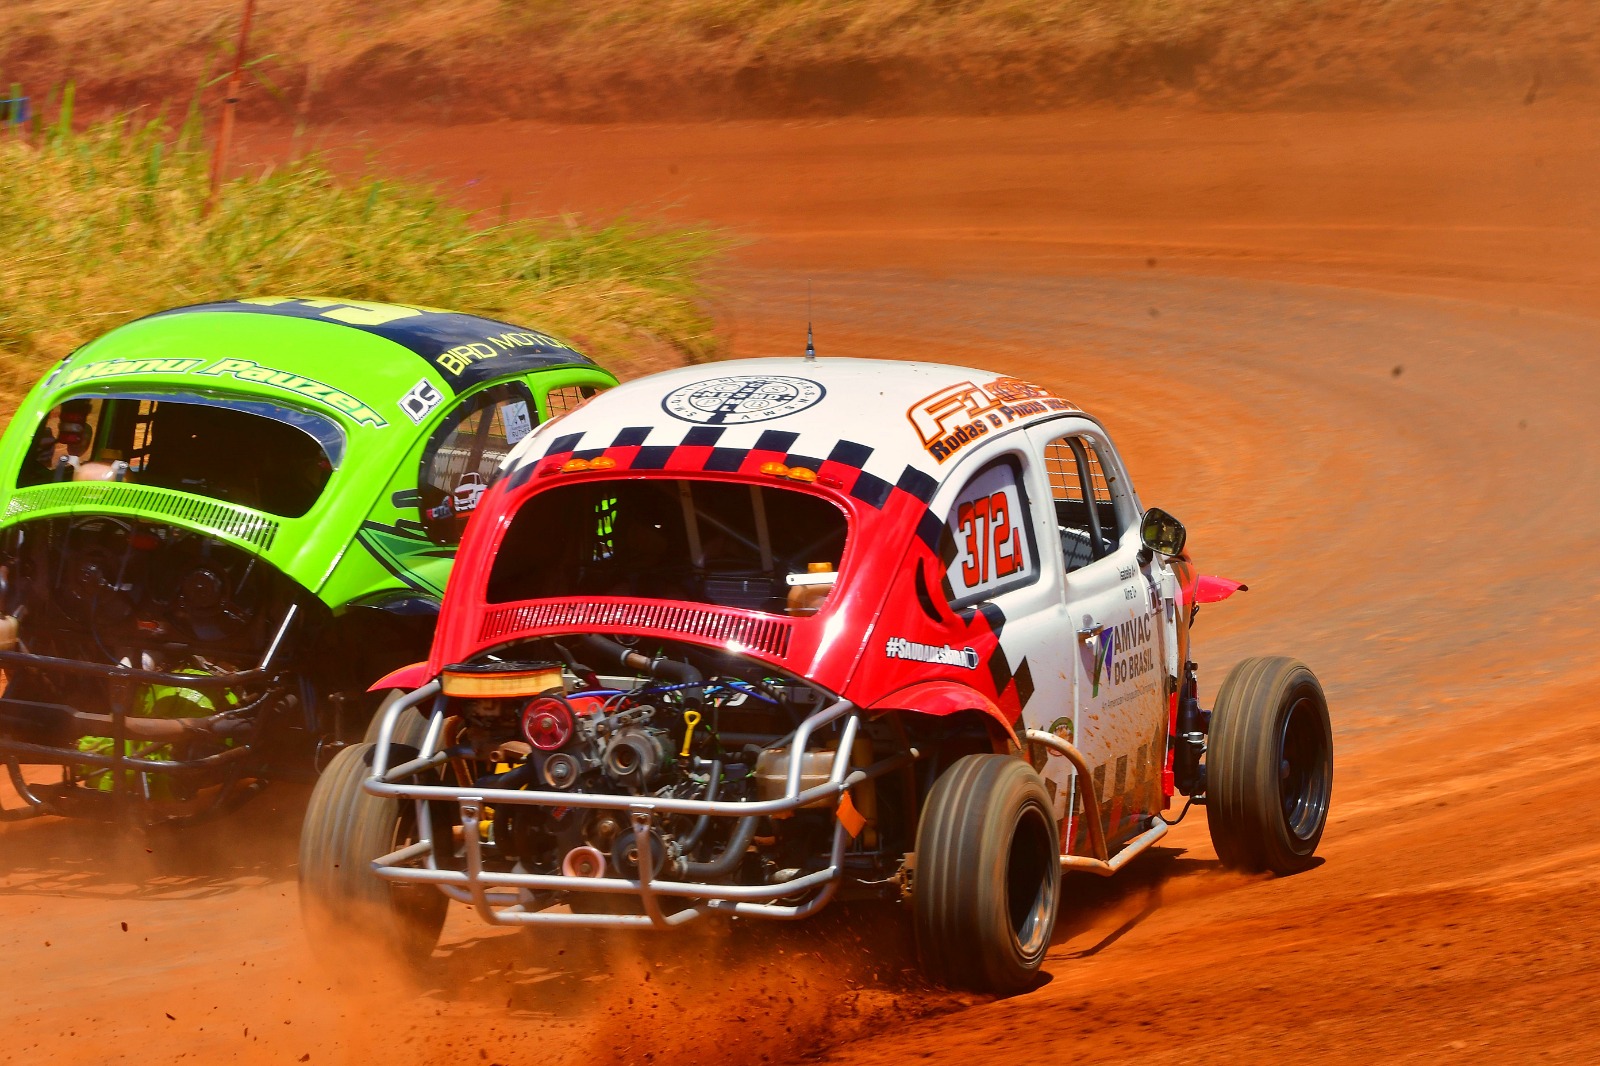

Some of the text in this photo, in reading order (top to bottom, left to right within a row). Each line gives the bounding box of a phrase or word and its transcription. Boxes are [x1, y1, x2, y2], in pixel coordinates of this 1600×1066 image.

[436, 343, 498, 376] BIRD
[63, 358, 388, 427] Manu Pauzer
[929, 419, 987, 461] Rodas
[989, 413, 1003, 426] e
[1001, 400, 1046, 422] Pneus
[1114, 612, 1151, 655] AMVAC
[1114, 648, 1153, 685] DO BRASIL
